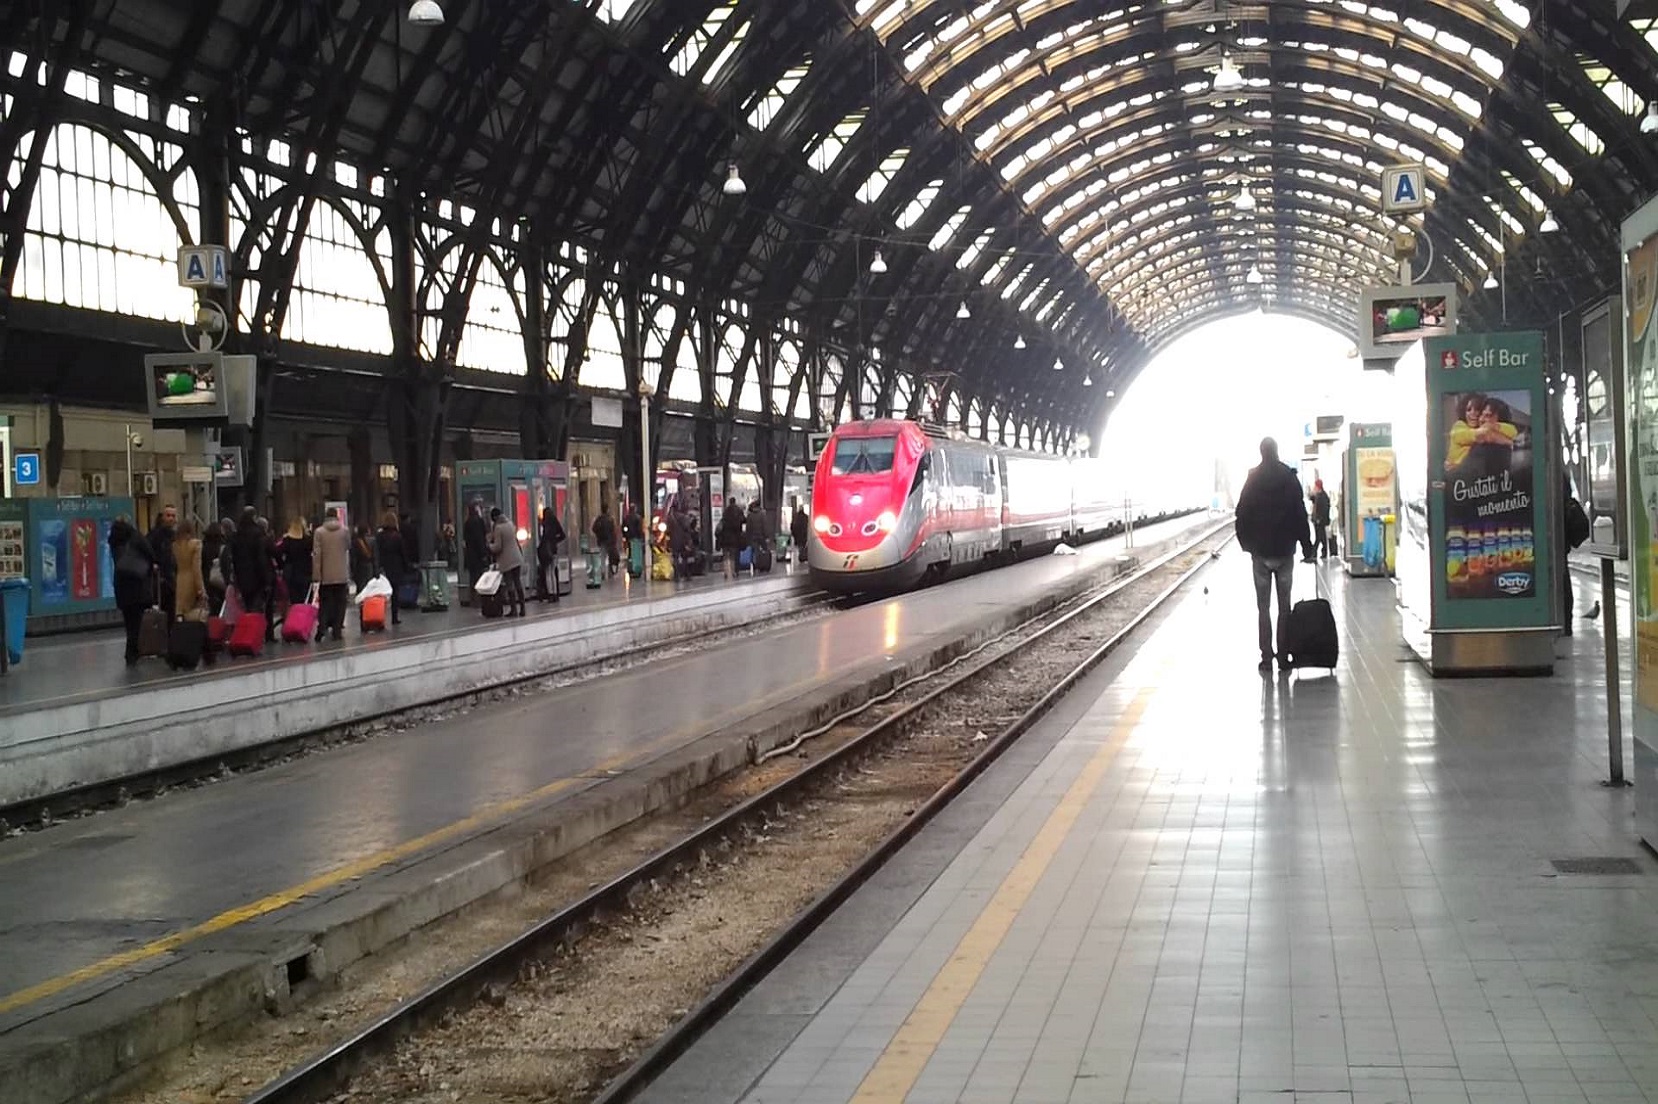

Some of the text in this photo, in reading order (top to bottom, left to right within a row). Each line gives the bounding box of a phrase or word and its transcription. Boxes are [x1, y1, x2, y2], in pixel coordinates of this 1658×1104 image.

[1394, 174, 1417, 202] A
[187, 254, 205, 280] A
[214, 254, 223, 279] A
[1462, 349, 1529, 368] Self Bar
[21, 461, 32, 476] 3
[1453, 469, 1513, 501] Gustati il
[1477, 490, 1531, 517] momento
[1498, 577, 1530, 588] Derby
